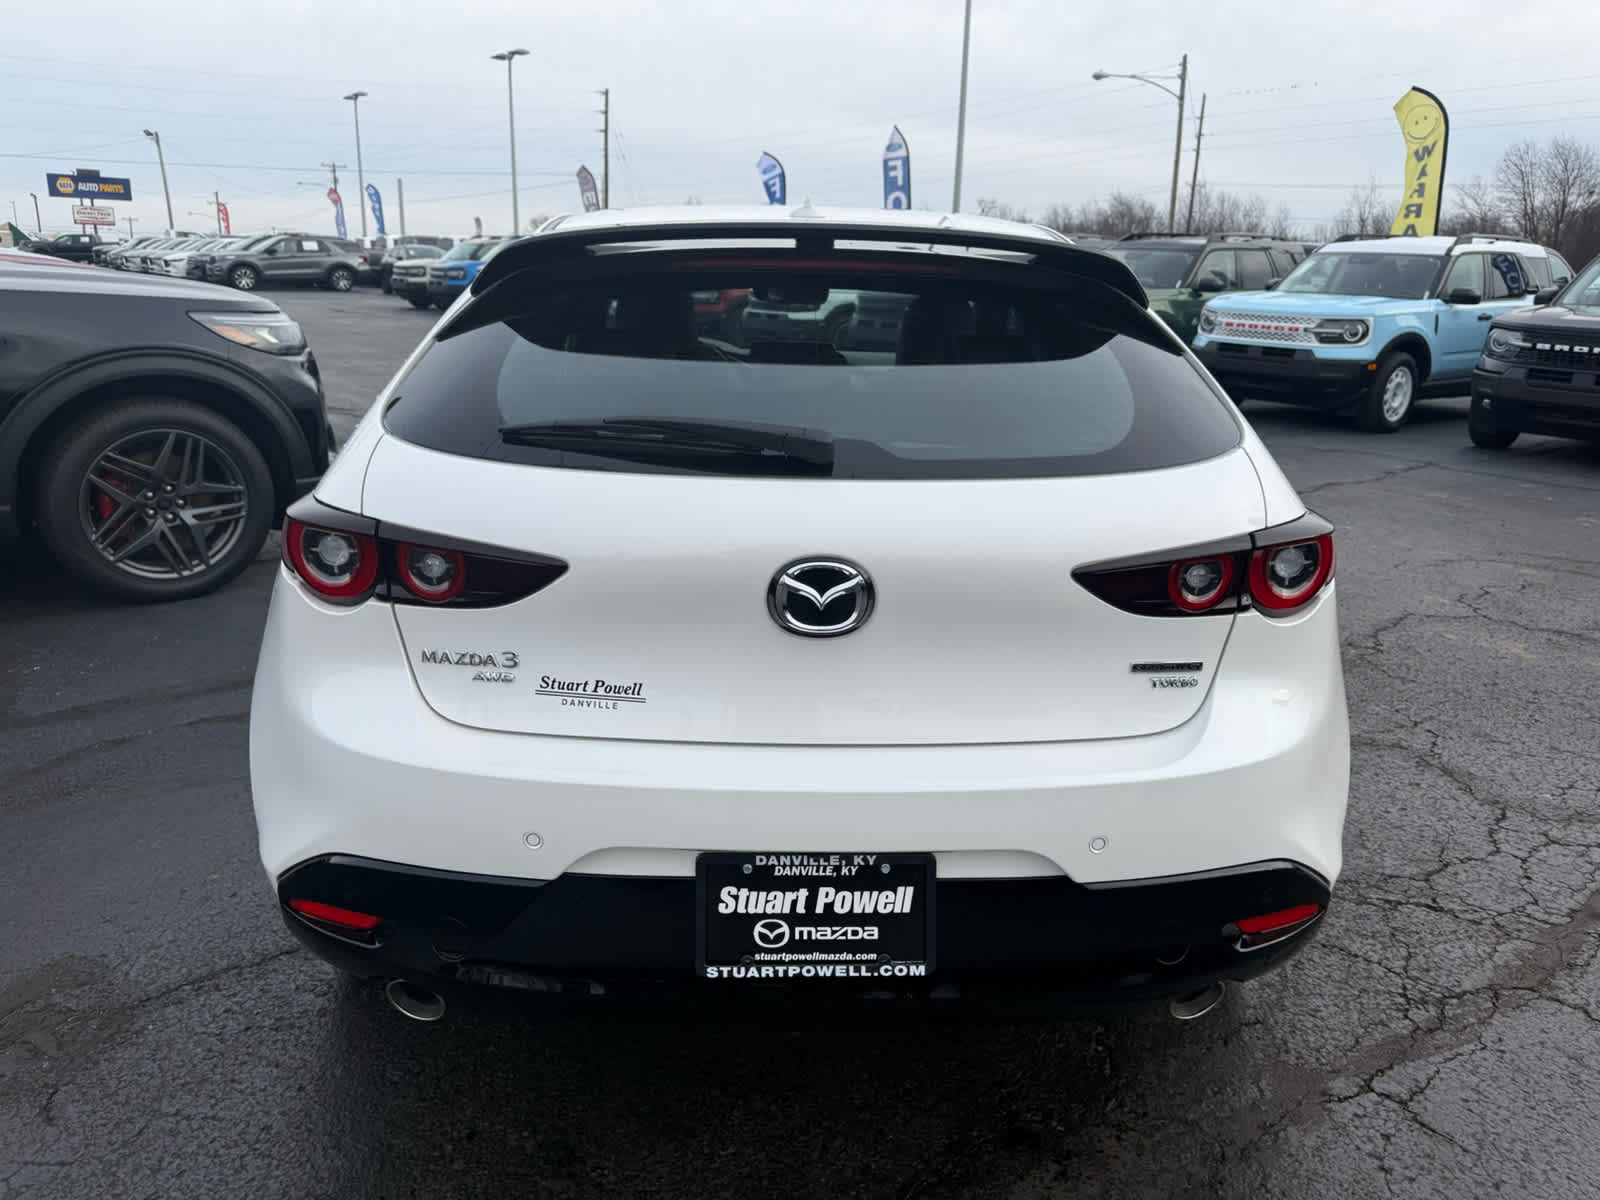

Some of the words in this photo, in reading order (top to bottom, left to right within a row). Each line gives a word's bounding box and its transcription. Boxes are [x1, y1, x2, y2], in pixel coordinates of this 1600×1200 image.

[78, 182, 99, 192] AUTO
[1224, 321, 1300, 332] BRONCO
[539, 675, 589, 693] Stuart
[591, 679, 644, 697] Powell
[561, 698, 620, 710] DANVILLE
[755, 855, 846, 867] DANVILLE,
[853, 855, 877, 865] KY
[773, 865, 837, 878] DANVILLE,
[841, 865, 859, 876] KY
[718, 885, 809, 915] Stuart
[814, 885, 915, 915] Powell
[794, 926, 879, 940] mazda
[754, 951, 877, 962] stuartpowellmazda.com
[706, 964, 926, 979] STUARTPOWELL.COM
